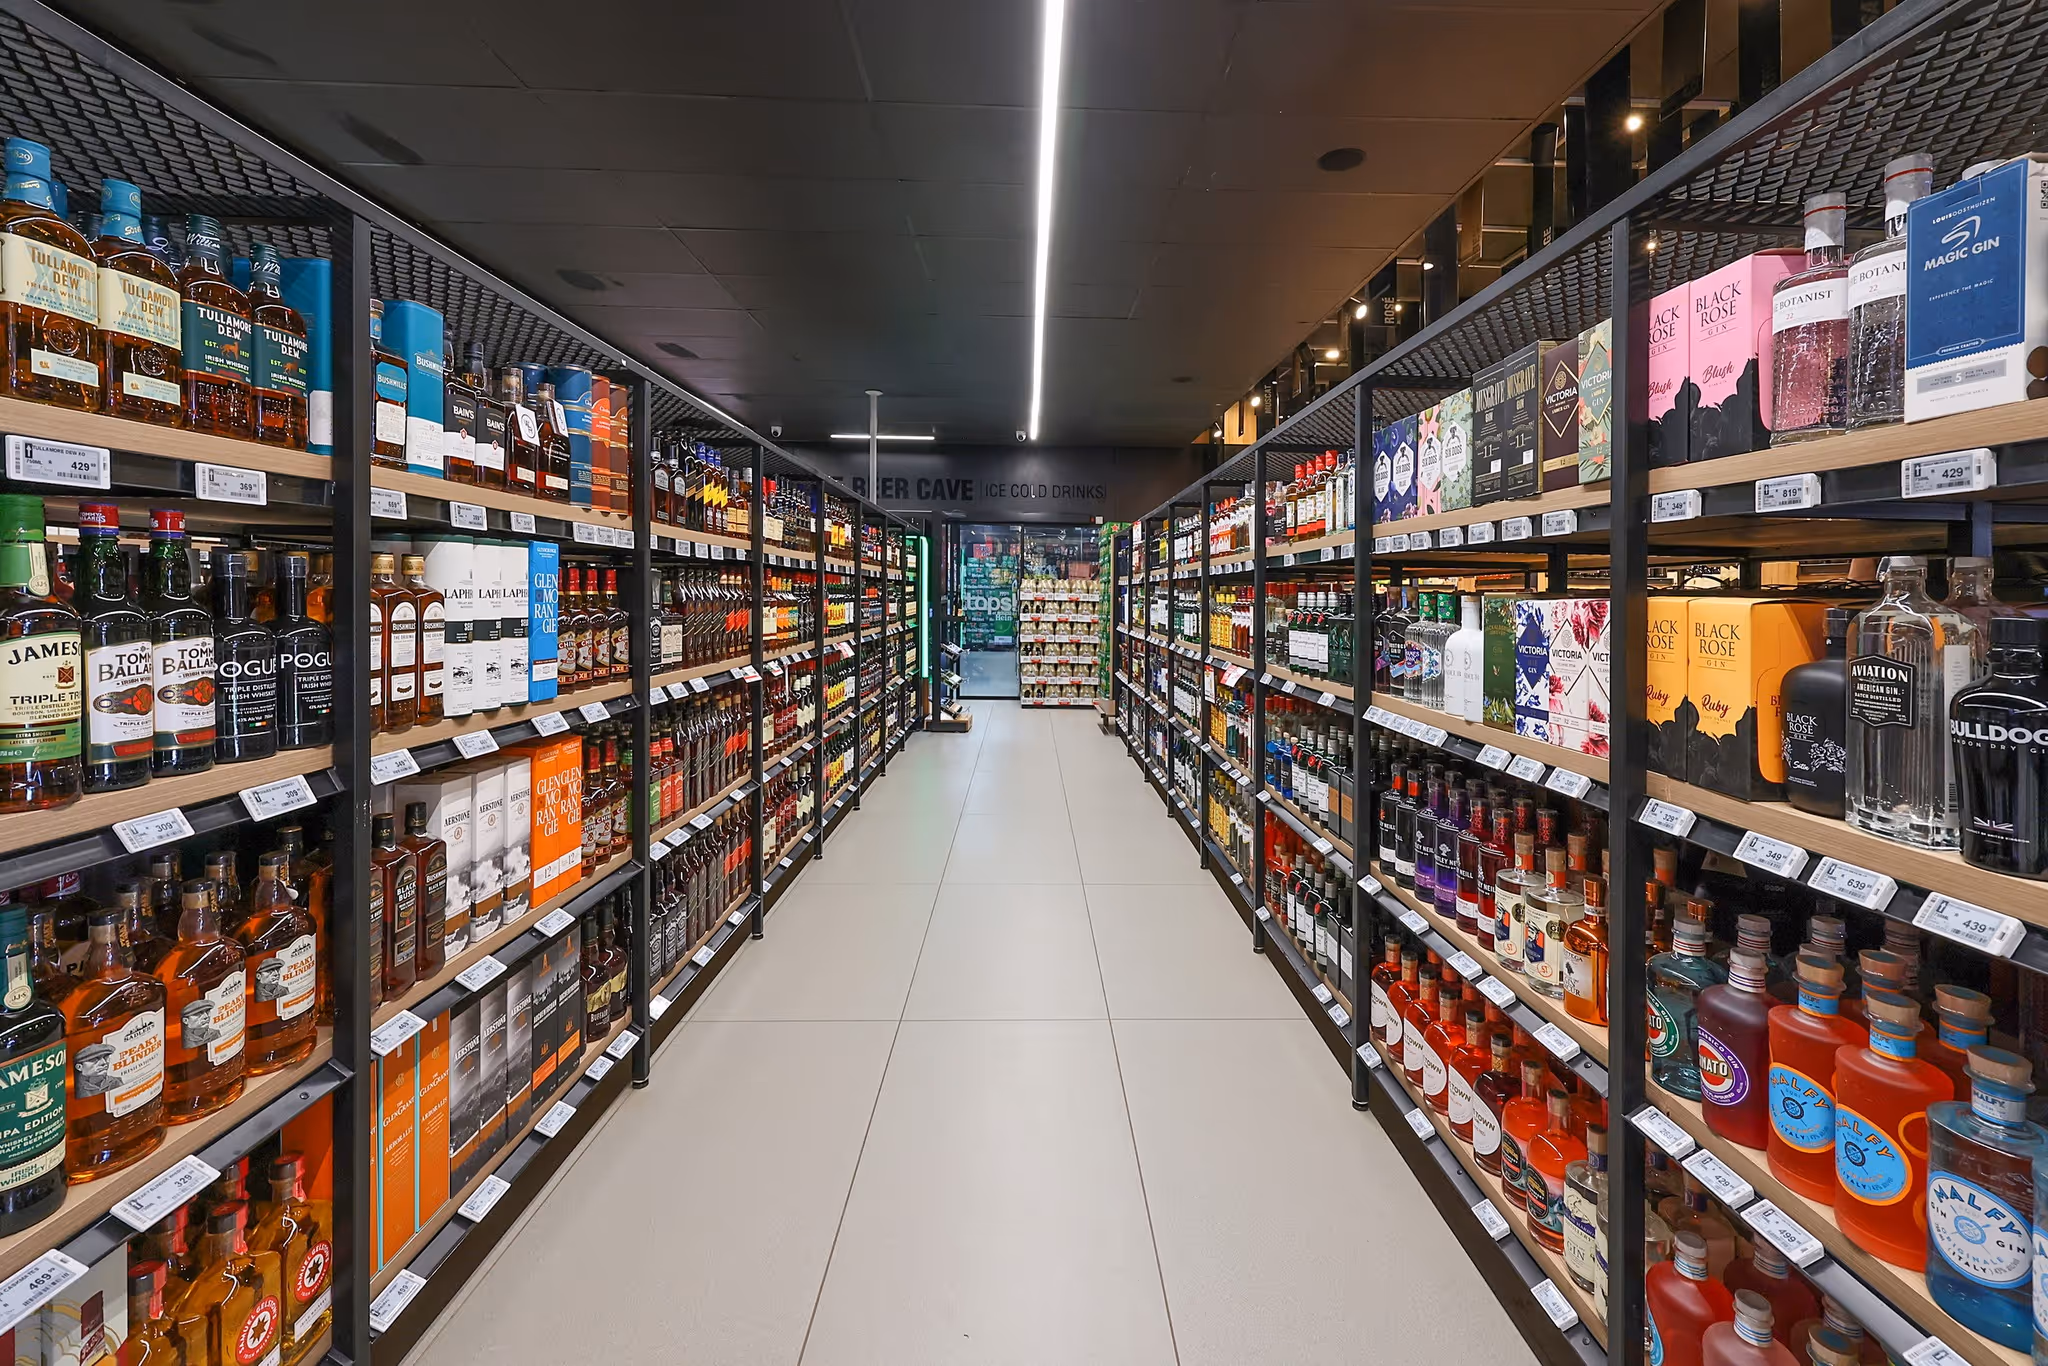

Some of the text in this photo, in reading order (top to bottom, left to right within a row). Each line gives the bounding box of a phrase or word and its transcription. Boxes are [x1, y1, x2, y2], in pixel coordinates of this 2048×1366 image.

[1924, 236, 2000, 272] MAGIC GIN
[1859, 261, 1906, 282] BOTANI
[53, 271, 80, 291] DEW
[1868, 284, 1879, 293] 22
[1929, 278, 1994, 301] EXPERIENCE THE MAGIC
[1695, 280, 1742, 313] BLACK
[1779, 289, 1834, 311] BOTANIST
[141, 300, 164, 318] DEW
[1649, 305, 1680, 330] ACK
[1701, 300, 1737, 328] ROSE
[1786, 312, 1794, 320] 22
[197, 307, 252, 334] TULLAMORE
[1708, 323, 1727, 336] GIN
[263, 329, 308, 353] TULLAMORE
[1651, 344, 1668, 356] GIN
[205, 354, 250, 371] IRISH WHISKEY
[271, 372, 288, 382] IRISH
[1506, 363, 1536, 400] MUSGRAVE
[1702, 361, 1735, 385] Blush
[1955, 372, 1962, 383] 5
[377, 374, 407, 390] BUSHMILLS
[1648, 378, 1674, 398] Blush
[1475, 379, 1505, 414] MUSGRAVE
[1545, 386, 1578, 405] VICTORIA
[1591, 397, 1604, 407] GIN
[453, 404, 475, 419] BAIN'S
[486, 418, 505, 432] BAIN'S
[71, 461, 91, 473] 429
[1942, 467, 1964, 480] 429
[239, 482, 254, 492] 369
[917, 478, 973, 501] CAVE
[985, 483, 1104, 499] ICE COLD DRINKS
[1782, 488, 1797, 498] 819
[1672, 502, 1683, 511] 349
[534, 573, 558, 589] GLEN
[543, 589, 558, 604] MO
[534, 603, 554, 619] RAN
[392, 622, 416, 631] BUSHMILLS
[542, 619, 557, 634] GIE
[1646, 620, 1679, 635] LACK
[1695, 622, 1741, 641] BLACK
[8, 641, 81, 666] JAMES
[1518, 645, 1548, 656] VICTORIA
[1552, 649, 1583, 660] VICTORIA
[1649, 652, 1666, 660] GIN
[1699, 639, 1736, 657] ROSE
[1592, 652, 1610, 662] VICT
[1706, 659, 1726, 668] GIN
[297, 675, 317, 683] TRIPLE
[1851, 664, 1908, 683] AVIATION
[224, 684, 251, 693] TRIPLE
[1646, 684, 1671, 707] Ruby
[1856, 683, 1885, 694] AMERICAN
[10, 693, 66, 706] TRIPLE
[1701, 693, 1731, 719] Ruby
[1870, 694, 1902, 703] DISTILLED
[1786, 711, 1818, 727] BLACK
[1788, 721, 1814, 734] ROSE
[15, 732, 32, 740] EXTRA
[1950, 719, 2048, 746] BULLDOG
[1990, 743, 2017, 752] DRY
[1792, 760, 1810, 771] Satin
[560, 765, 582, 784] GLEN
[536, 775, 561, 796] GLEN
[568, 779, 582, 795] MO
[285, 790, 299, 799] 309
[510, 788, 530, 802] AERSTONE
[545, 789, 561, 806] MO
[479, 799, 503, 814] AERSTONE
[560, 796, 579, 814] RAN
[444, 810, 470, 828] AERSTONE
[536, 807, 557, 826] RAN
[567, 809, 581, 825] GIE
[1662, 813, 1675, 823] 329
[155, 821, 173, 834] 309
[544, 819, 559, 837] GIE
[568, 852, 575, 865] 12
[1765, 850, 1782, 861] 349
[543, 866, 552, 879] 12
[396, 881, 417, 896] BLACK
[1846, 878, 1866, 891] 639
[398, 889, 416, 902] BUSH
[1962, 919, 1987, 934] 439
[282, 961, 315, 982] BLINDER
[287, 954, 315, 972] PEAKY
[213, 1000, 245, 1024] BLINDER
[217, 994, 245, 1014] PEAKY
[510, 994, 532, 1017] AERSTONE
[483, 1014, 507, 1037] AERSTONE
[112, 1040, 161, 1071] BLINDER
[119, 1034, 159, 1061] PEAKY
[454, 1035, 480, 1061] AERSTONE
[0, 1049, 67, 1090] AMESO
[419, 1068, 450, 1098] GLENGRANT
[1770, 1073, 1830, 1109] MALFY
[1973, 1089, 2006, 1109] MALFY
[24, 1105, 64, 1131] EDITION
[383, 1095, 416, 1128] GLENGRANT
[421, 1097, 448, 1123] ARBORALIS
[384, 1126, 413, 1155] ARBORALIS
[1780, 1124, 1805, 1141] ITALY
[23, 1136, 43, 1148] BEER
[0, 1165, 46, 1188] WHISKEY
[11, 1163, 38, 1179] IRISH
[174, 1174, 192, 1188] 329
[1714, 1173, 1731, 1188] 429
[1842, 1170, 1867, 1190] ITALY
[1933, 1183, 2023, 1238] MALFY
[1778, 1229, 1796, 1243] 499
[1940, 1226, 2004, 1266] ORIGINALE
[1952, 1251, 1987, 1274] ITALY
[3, 1267, 40, 1293] CASKMATES
[29, 1274, 52, 1291] 469
[297, 1256, 311, 1292] SAMUEL
[239, 1315, 255, 1354] SAMUEL
